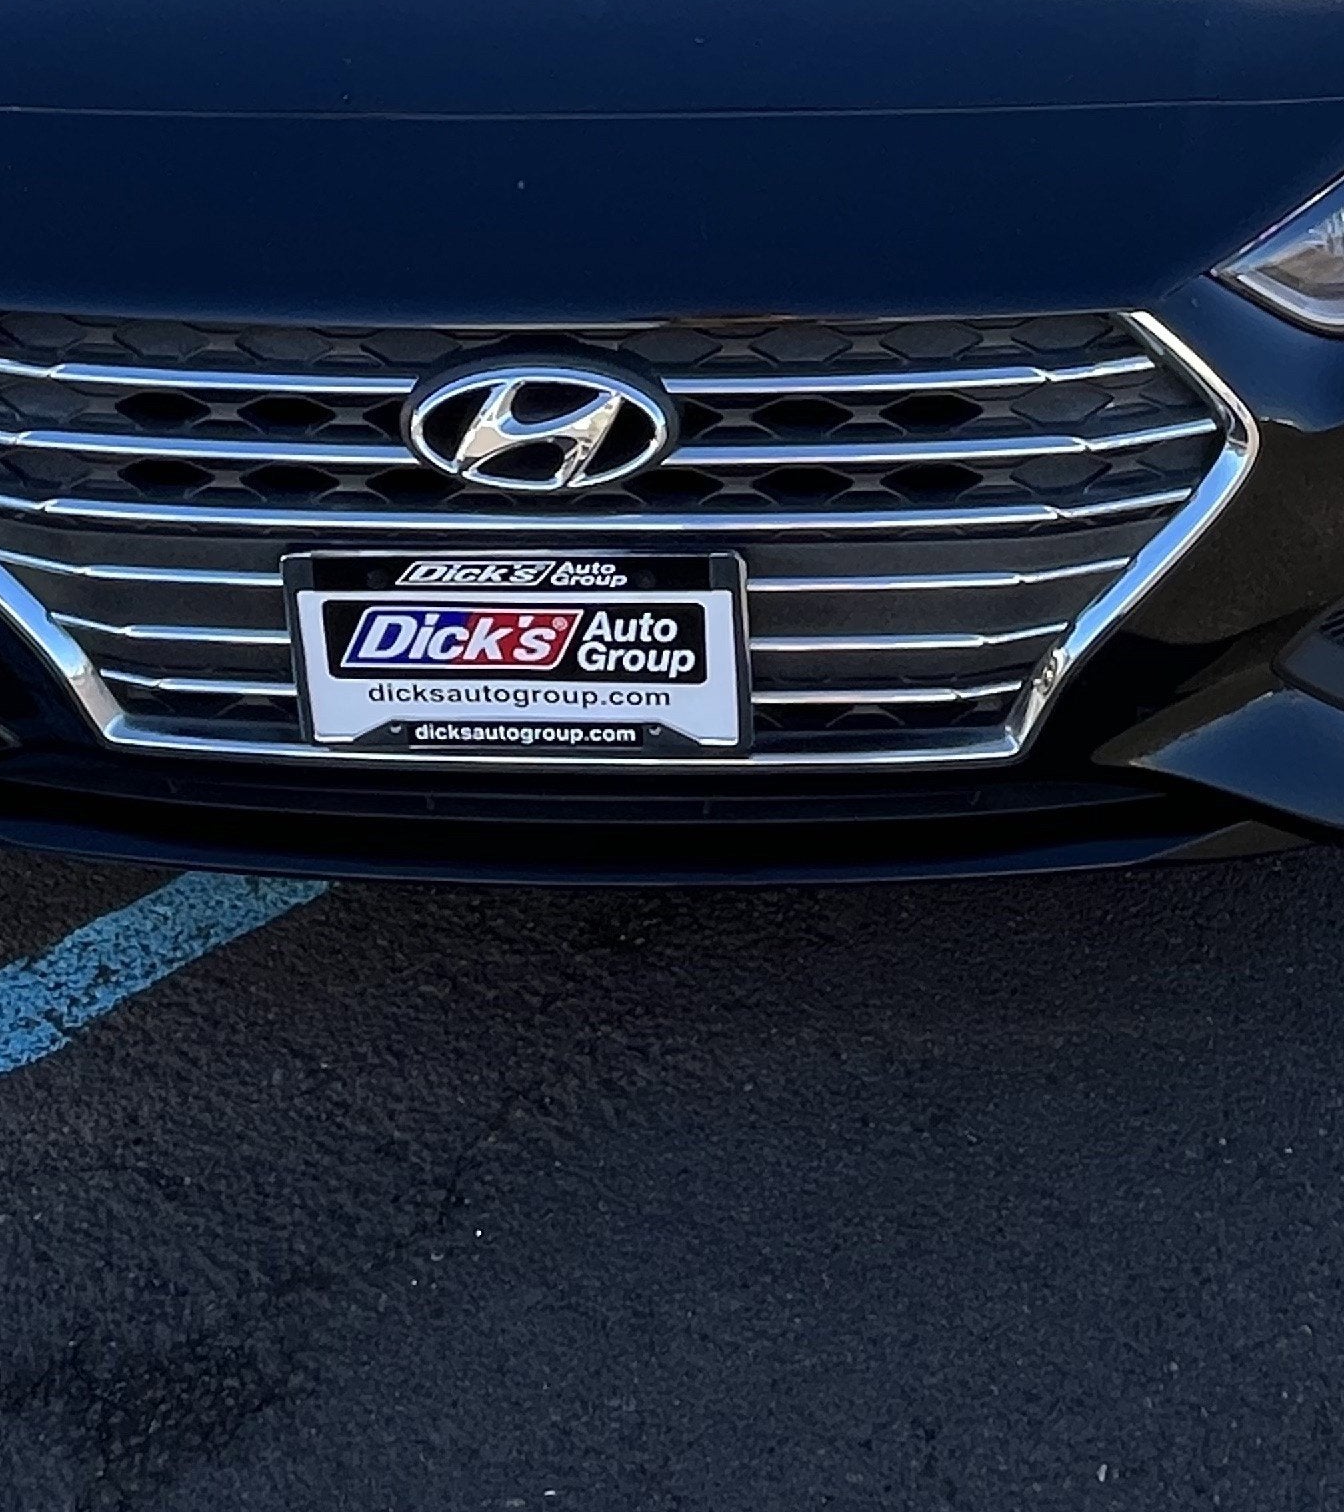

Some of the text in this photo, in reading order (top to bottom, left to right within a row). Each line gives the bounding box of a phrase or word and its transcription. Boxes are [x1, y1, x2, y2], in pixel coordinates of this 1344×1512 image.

[550, 573, 628, 587] Group
[556, 561, 616, 575] Auto
[356, 612, 557, 662] Dick's
[582, 611, 678, 644] Auto
[576, 644, 696, 678] Group
[367, 683, 671, 708] dicksautogroup.com
[414, 722, 637, 744] dicksautogroup.com
